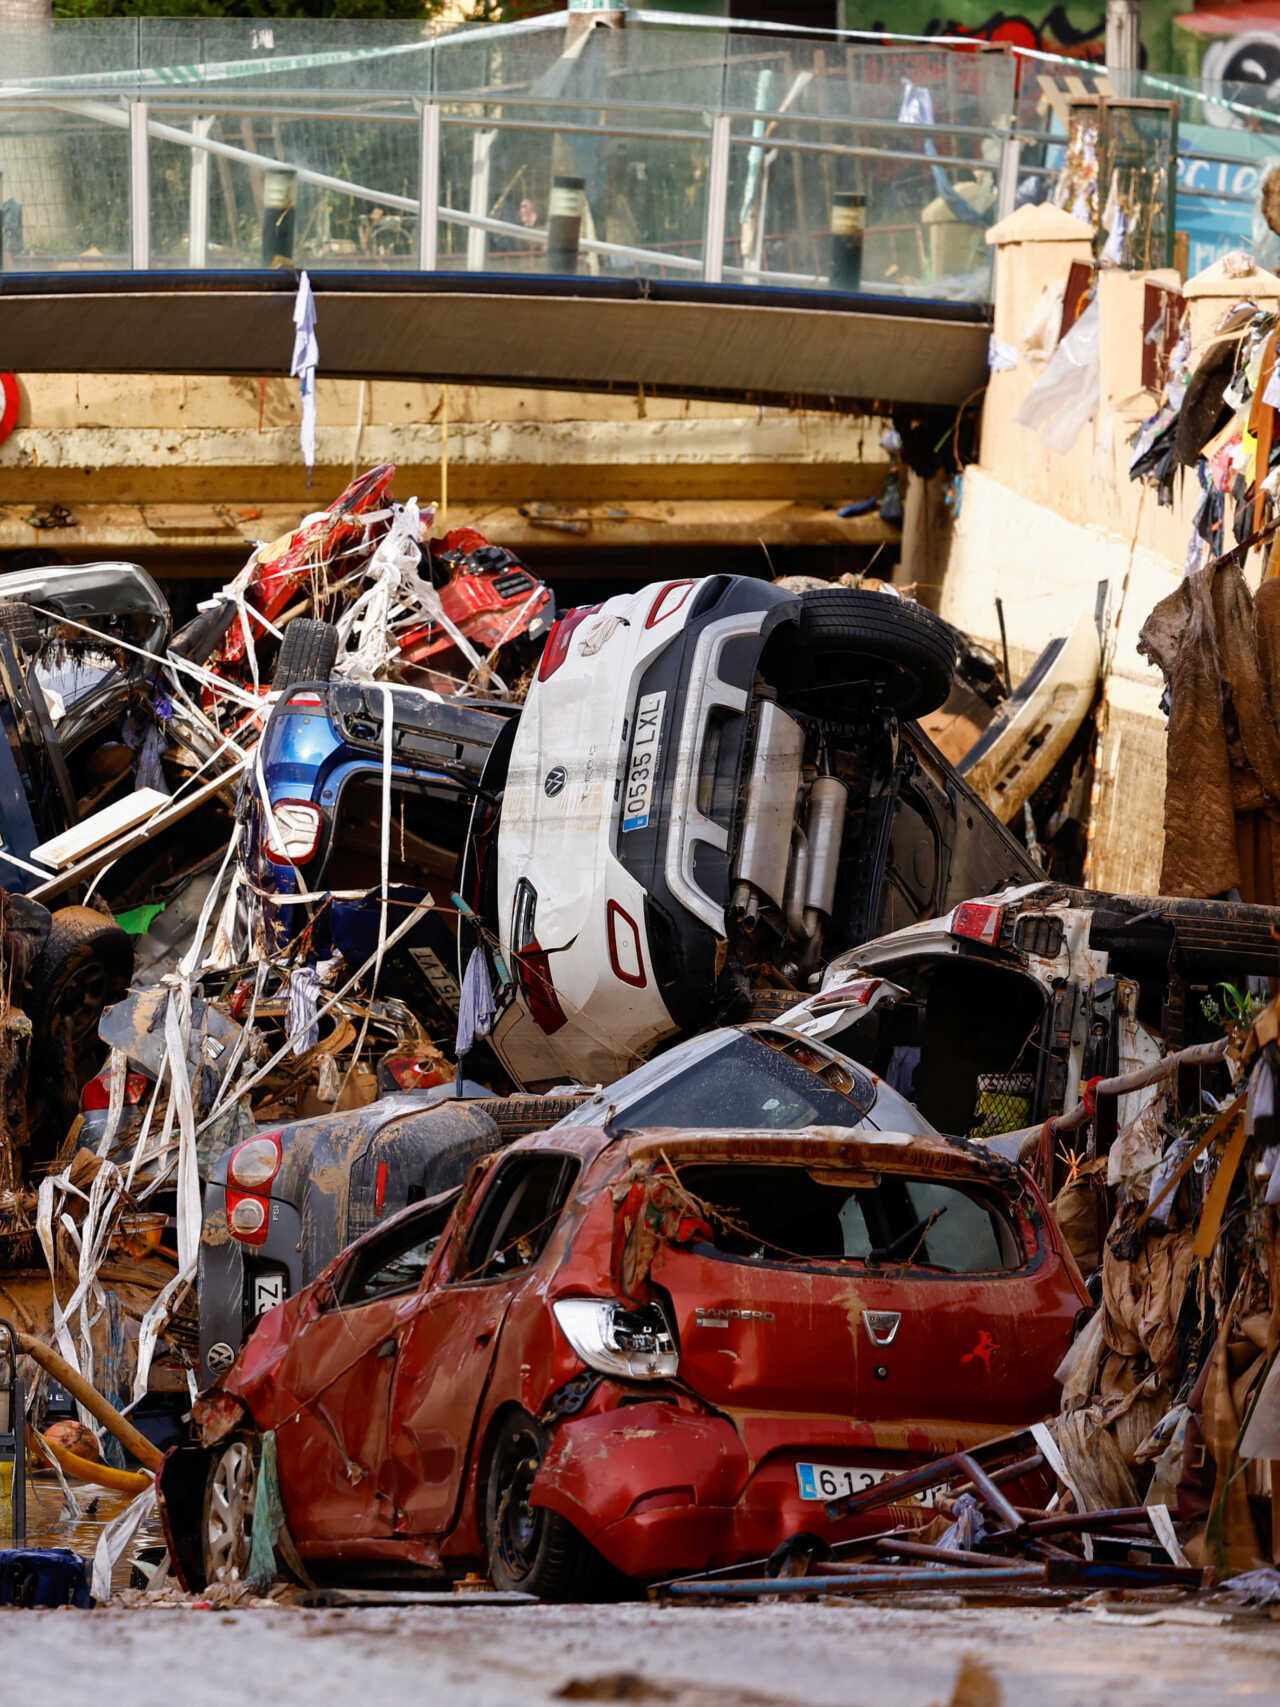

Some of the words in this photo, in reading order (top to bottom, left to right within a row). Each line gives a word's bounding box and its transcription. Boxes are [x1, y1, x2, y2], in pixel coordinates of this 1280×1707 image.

[635, 699, 661, 746] LXL
[627, 751, 652, 813] 0535
[695, 1307, 776, 1321] SANDERO
